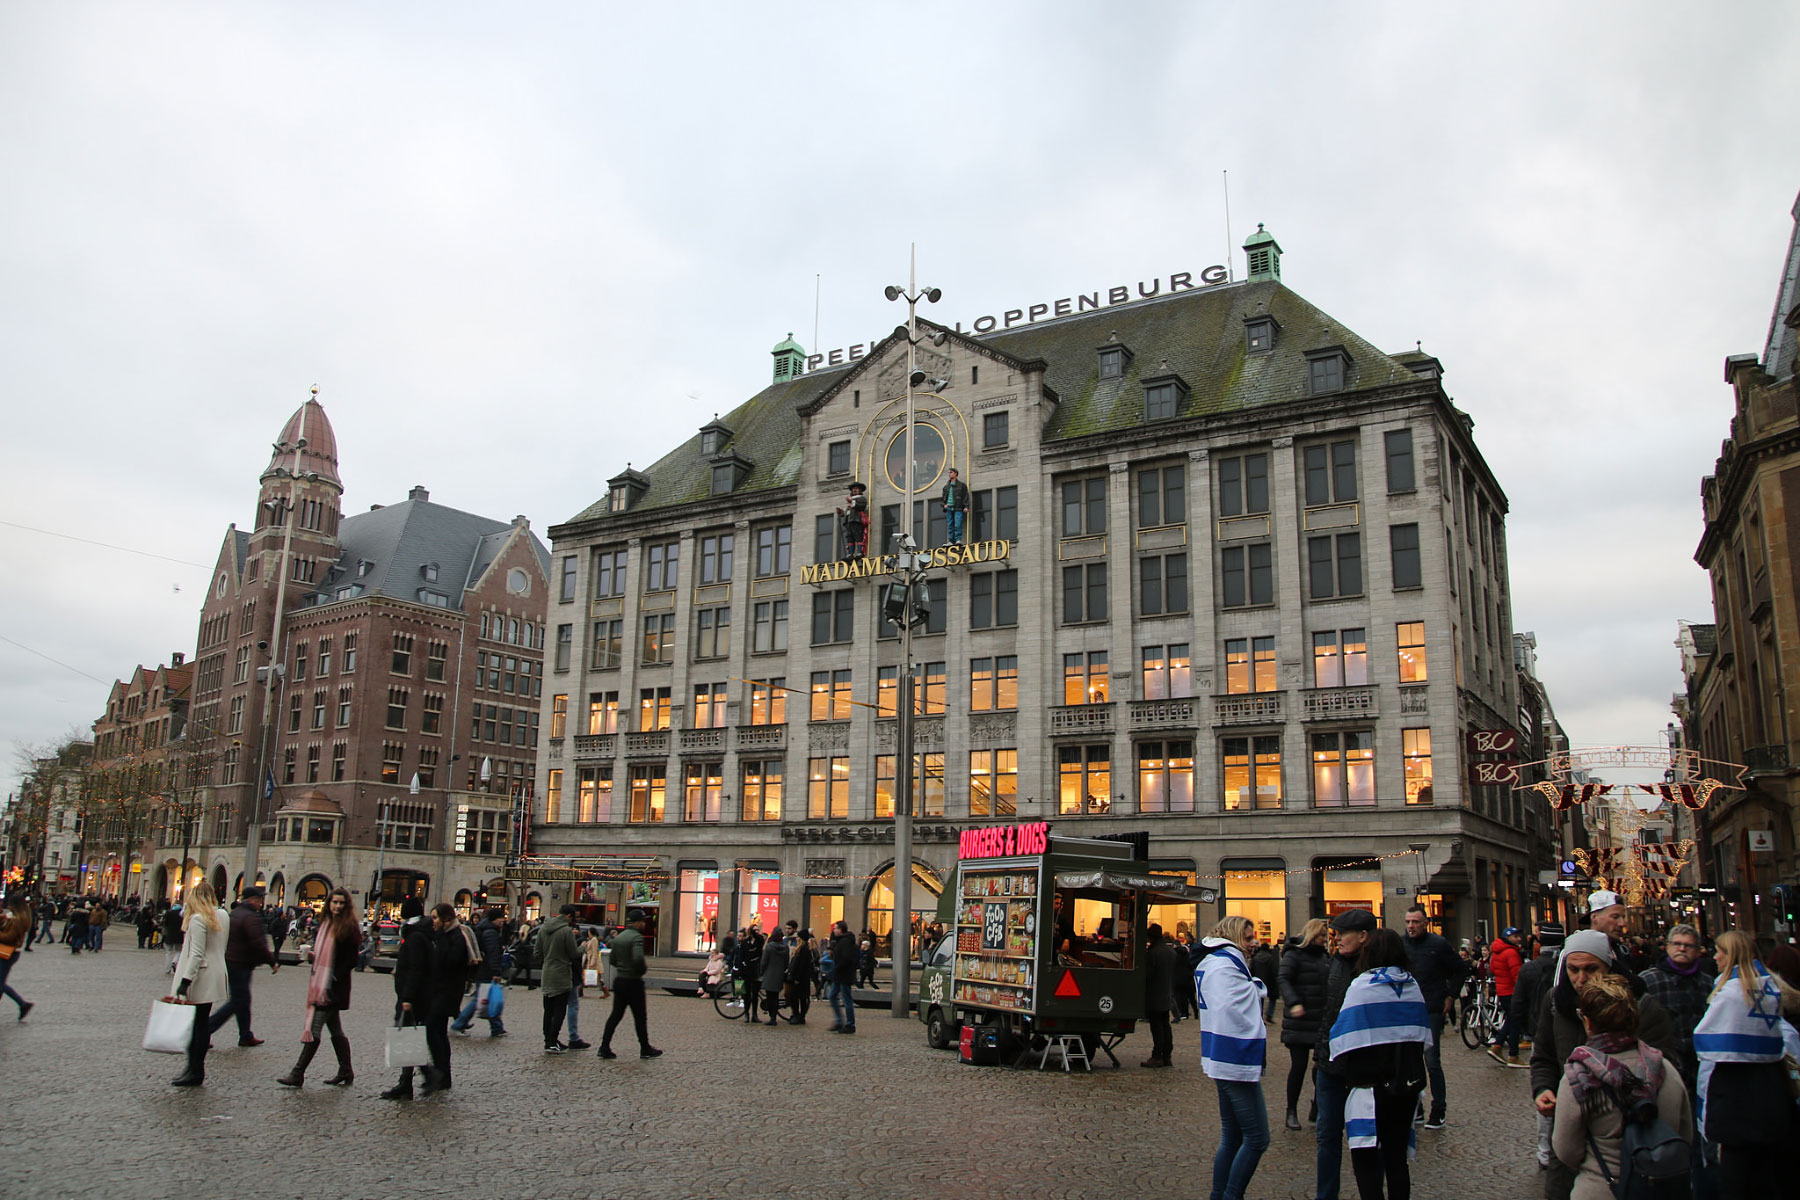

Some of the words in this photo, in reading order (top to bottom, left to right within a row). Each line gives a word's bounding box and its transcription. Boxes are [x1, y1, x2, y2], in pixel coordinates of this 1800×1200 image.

[955, 264, 1228, 336] LOPPENBURG
[913, 539, 1009, 569] USSAUD
[1473, 732, 1514, 751] P&C
[1475, 763, 1516, 782] P&C
[781, 827, 834, 839] PEEK
[838, 827, 853, 839] &
[959, 826, 1004, 859] BURGERS
[1005, 825, 1015, 856] &
[1016, 821, 1048, 855] DOGS
[485, 864, 504, 874] GAS
[510, 869, 545, 879] MAAME
[1100, 998, 1111, 1009] 25
